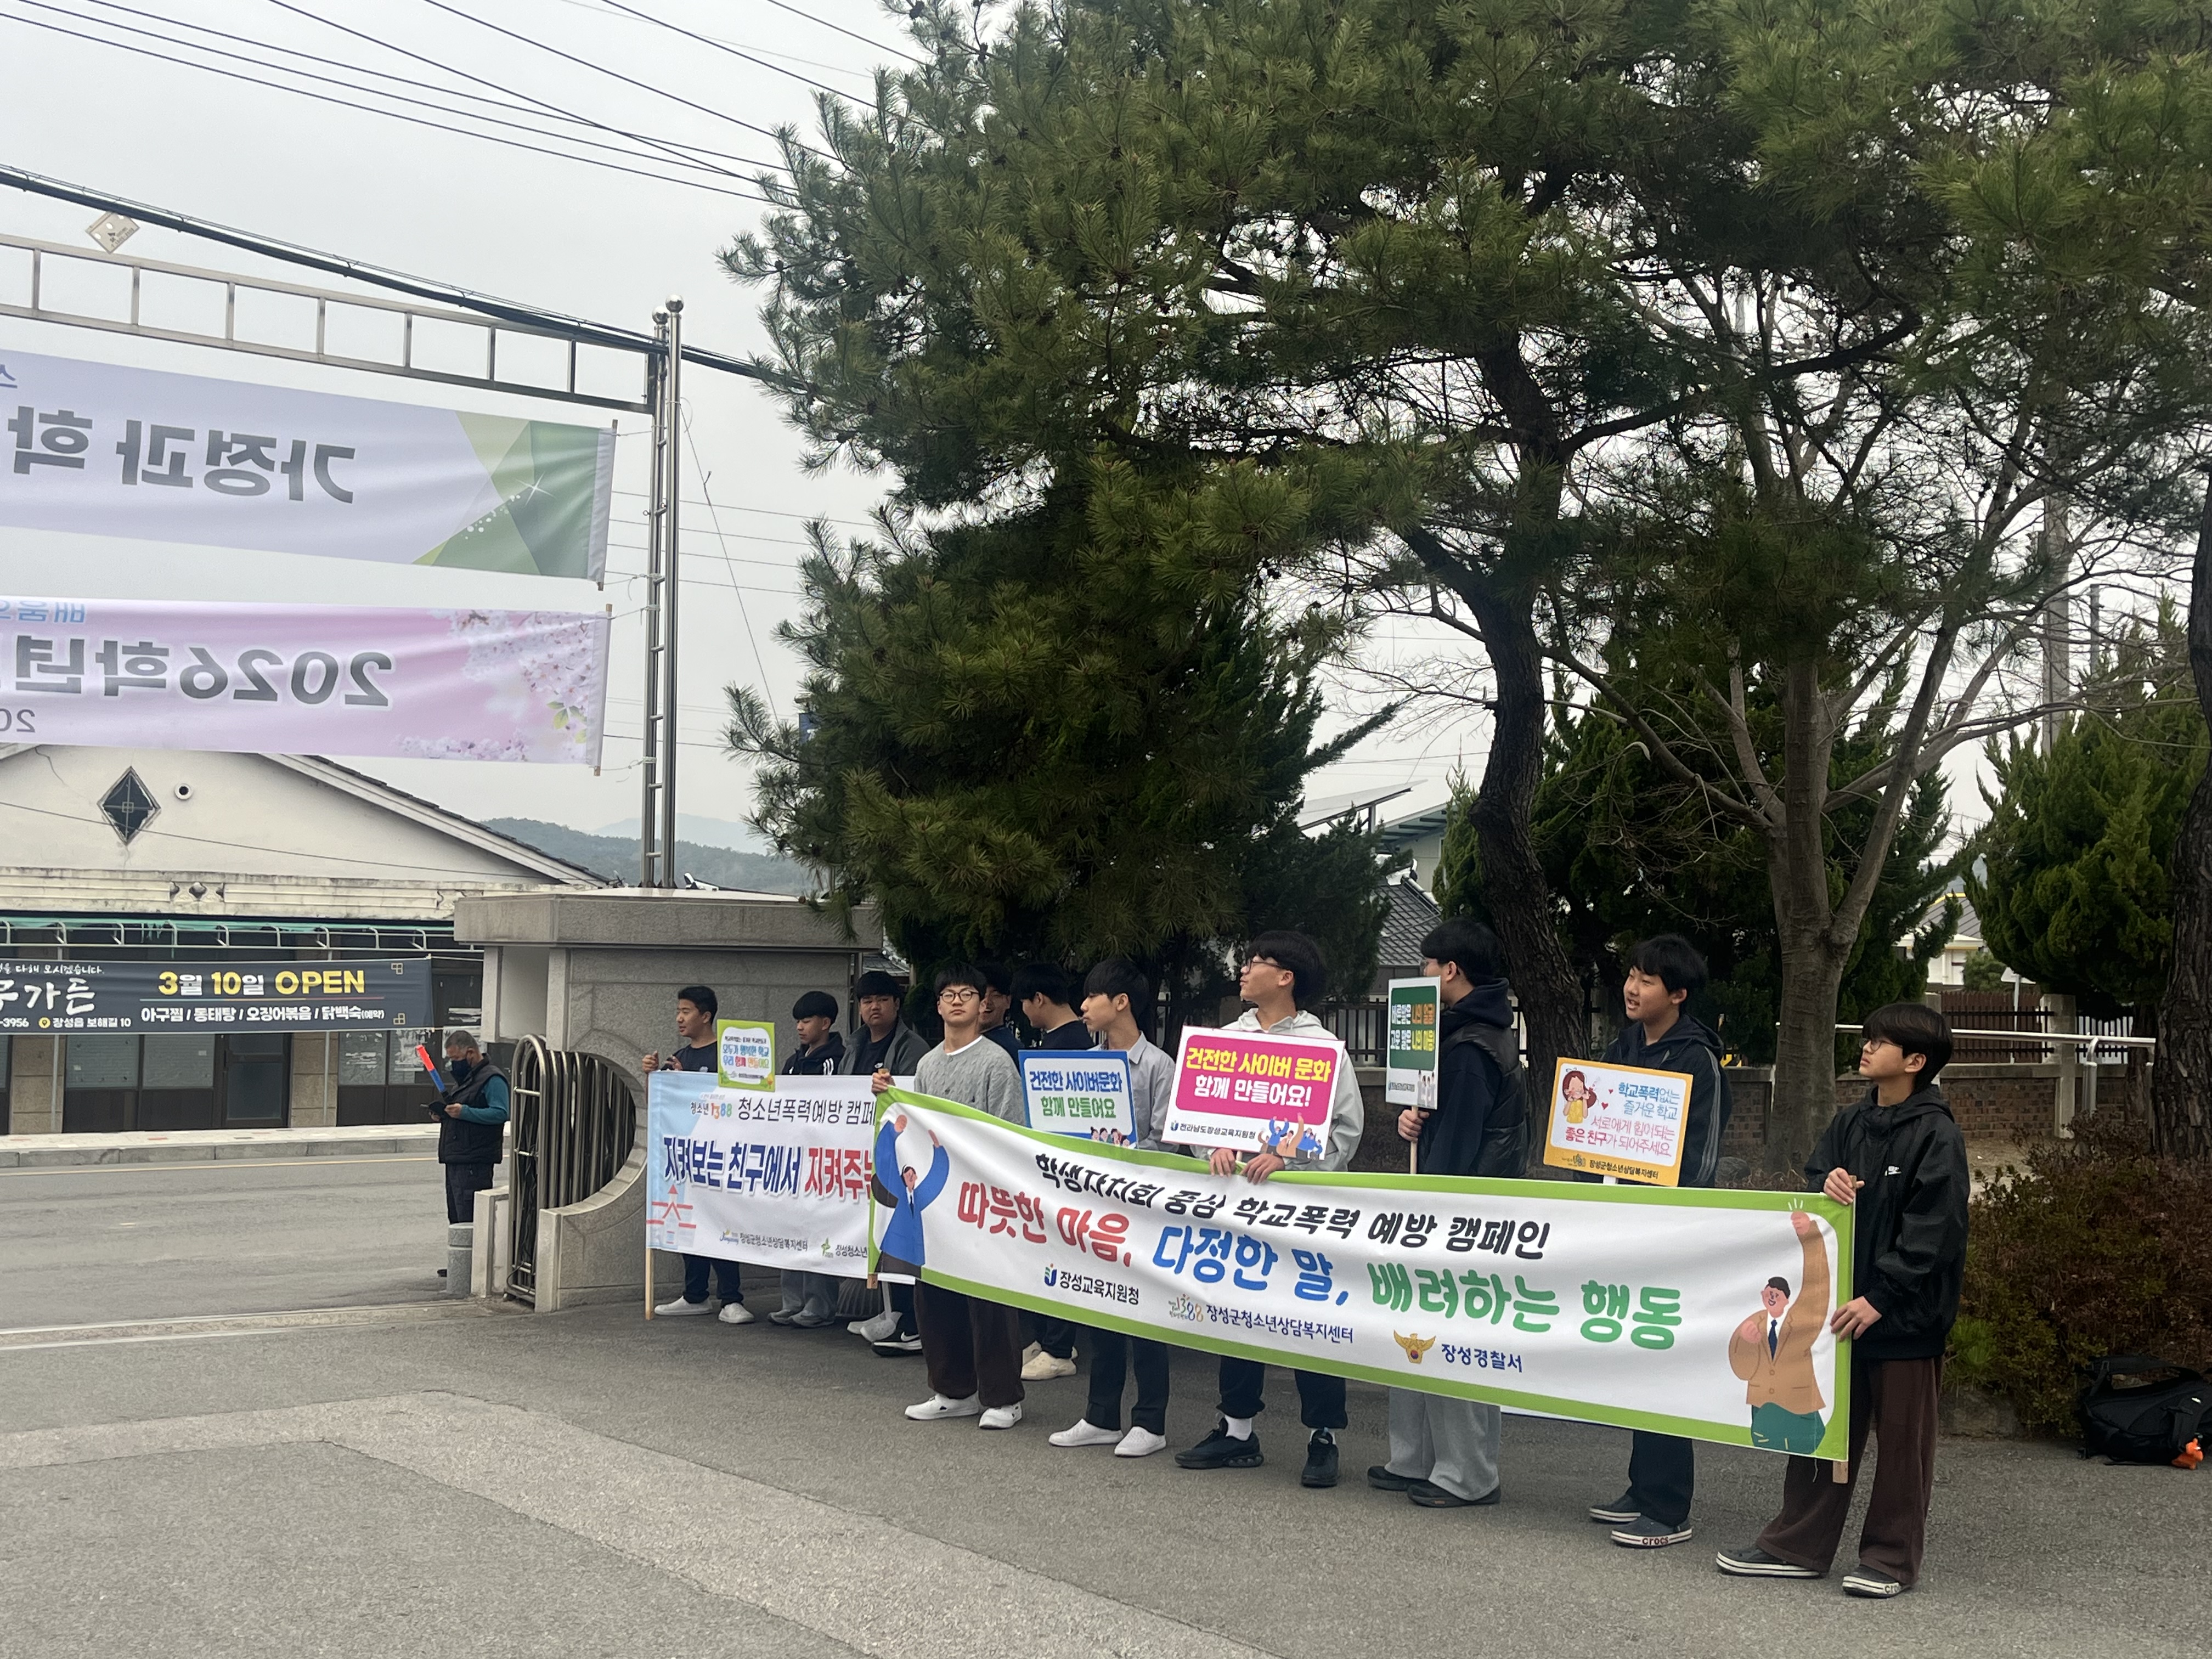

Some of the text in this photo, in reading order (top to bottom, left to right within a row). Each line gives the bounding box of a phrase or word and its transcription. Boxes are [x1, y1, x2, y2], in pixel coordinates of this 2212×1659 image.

[159, 970, 365, 996] 3월 10일 OPEN
[53, 1017, 84, 1028] 장성읍
[87, 1017, 117, 1028] 보해길
[120, 1018, 131, 1028] 10
[141, 1006, 184, 1022] 아구찜
[194, 1006, 236, 1022] 동태탕
[246, 1006, 312, 1022] 오징어볶음
[321, 1005, 385, 1021] 닭백숙(예약)
[1186, 1047, 1331, 1082] 건전한 사이버 문화
[1029, 1070, 1122, 1092] 건전한 사이버문화
[1194, 1074, 1312, 1108] 함께 만들어요!
[1618, 1081, 1680, 1105] 학교폭력없는
[690, 1101, 709, 1116] 청소년
[710, 1102, 732, 1120] 1388
[738, 1097, 843, 1124] 청소년폭력예방
[1041, 1096, 1116, 1118] 함께 만들어요
[1623, 1100, 1678, 1120] 즐거운 학교
[1180, 1123, 1256, 1139] 전라남도장성교육지원청
[1592, 1115, 1632, 1133] 서로에게
[1565, 1126, 1672, 1157] 좋은 친구가 되어주세요
[663, 1136, 724, 1188] 지켜보는
[727, 1141, 801, 1195] 친구에서
[1035, 1153, 1550, 1260] 학생자치회 중심 학교폭력 예방 캠페인
[957, 1181, 1682, 1350] 따뜻한 마음, 다정한 말, 배려하는 행동
[1060, 1271, 1139, 1305] 장성교육지원청
[1206, 1304, 1353, 1344] 장성군청소년상담복지센터
[1441, 1343, 1522, 1373] 장성경찰서
[1642, 1537, 1668, 1545] crocs
